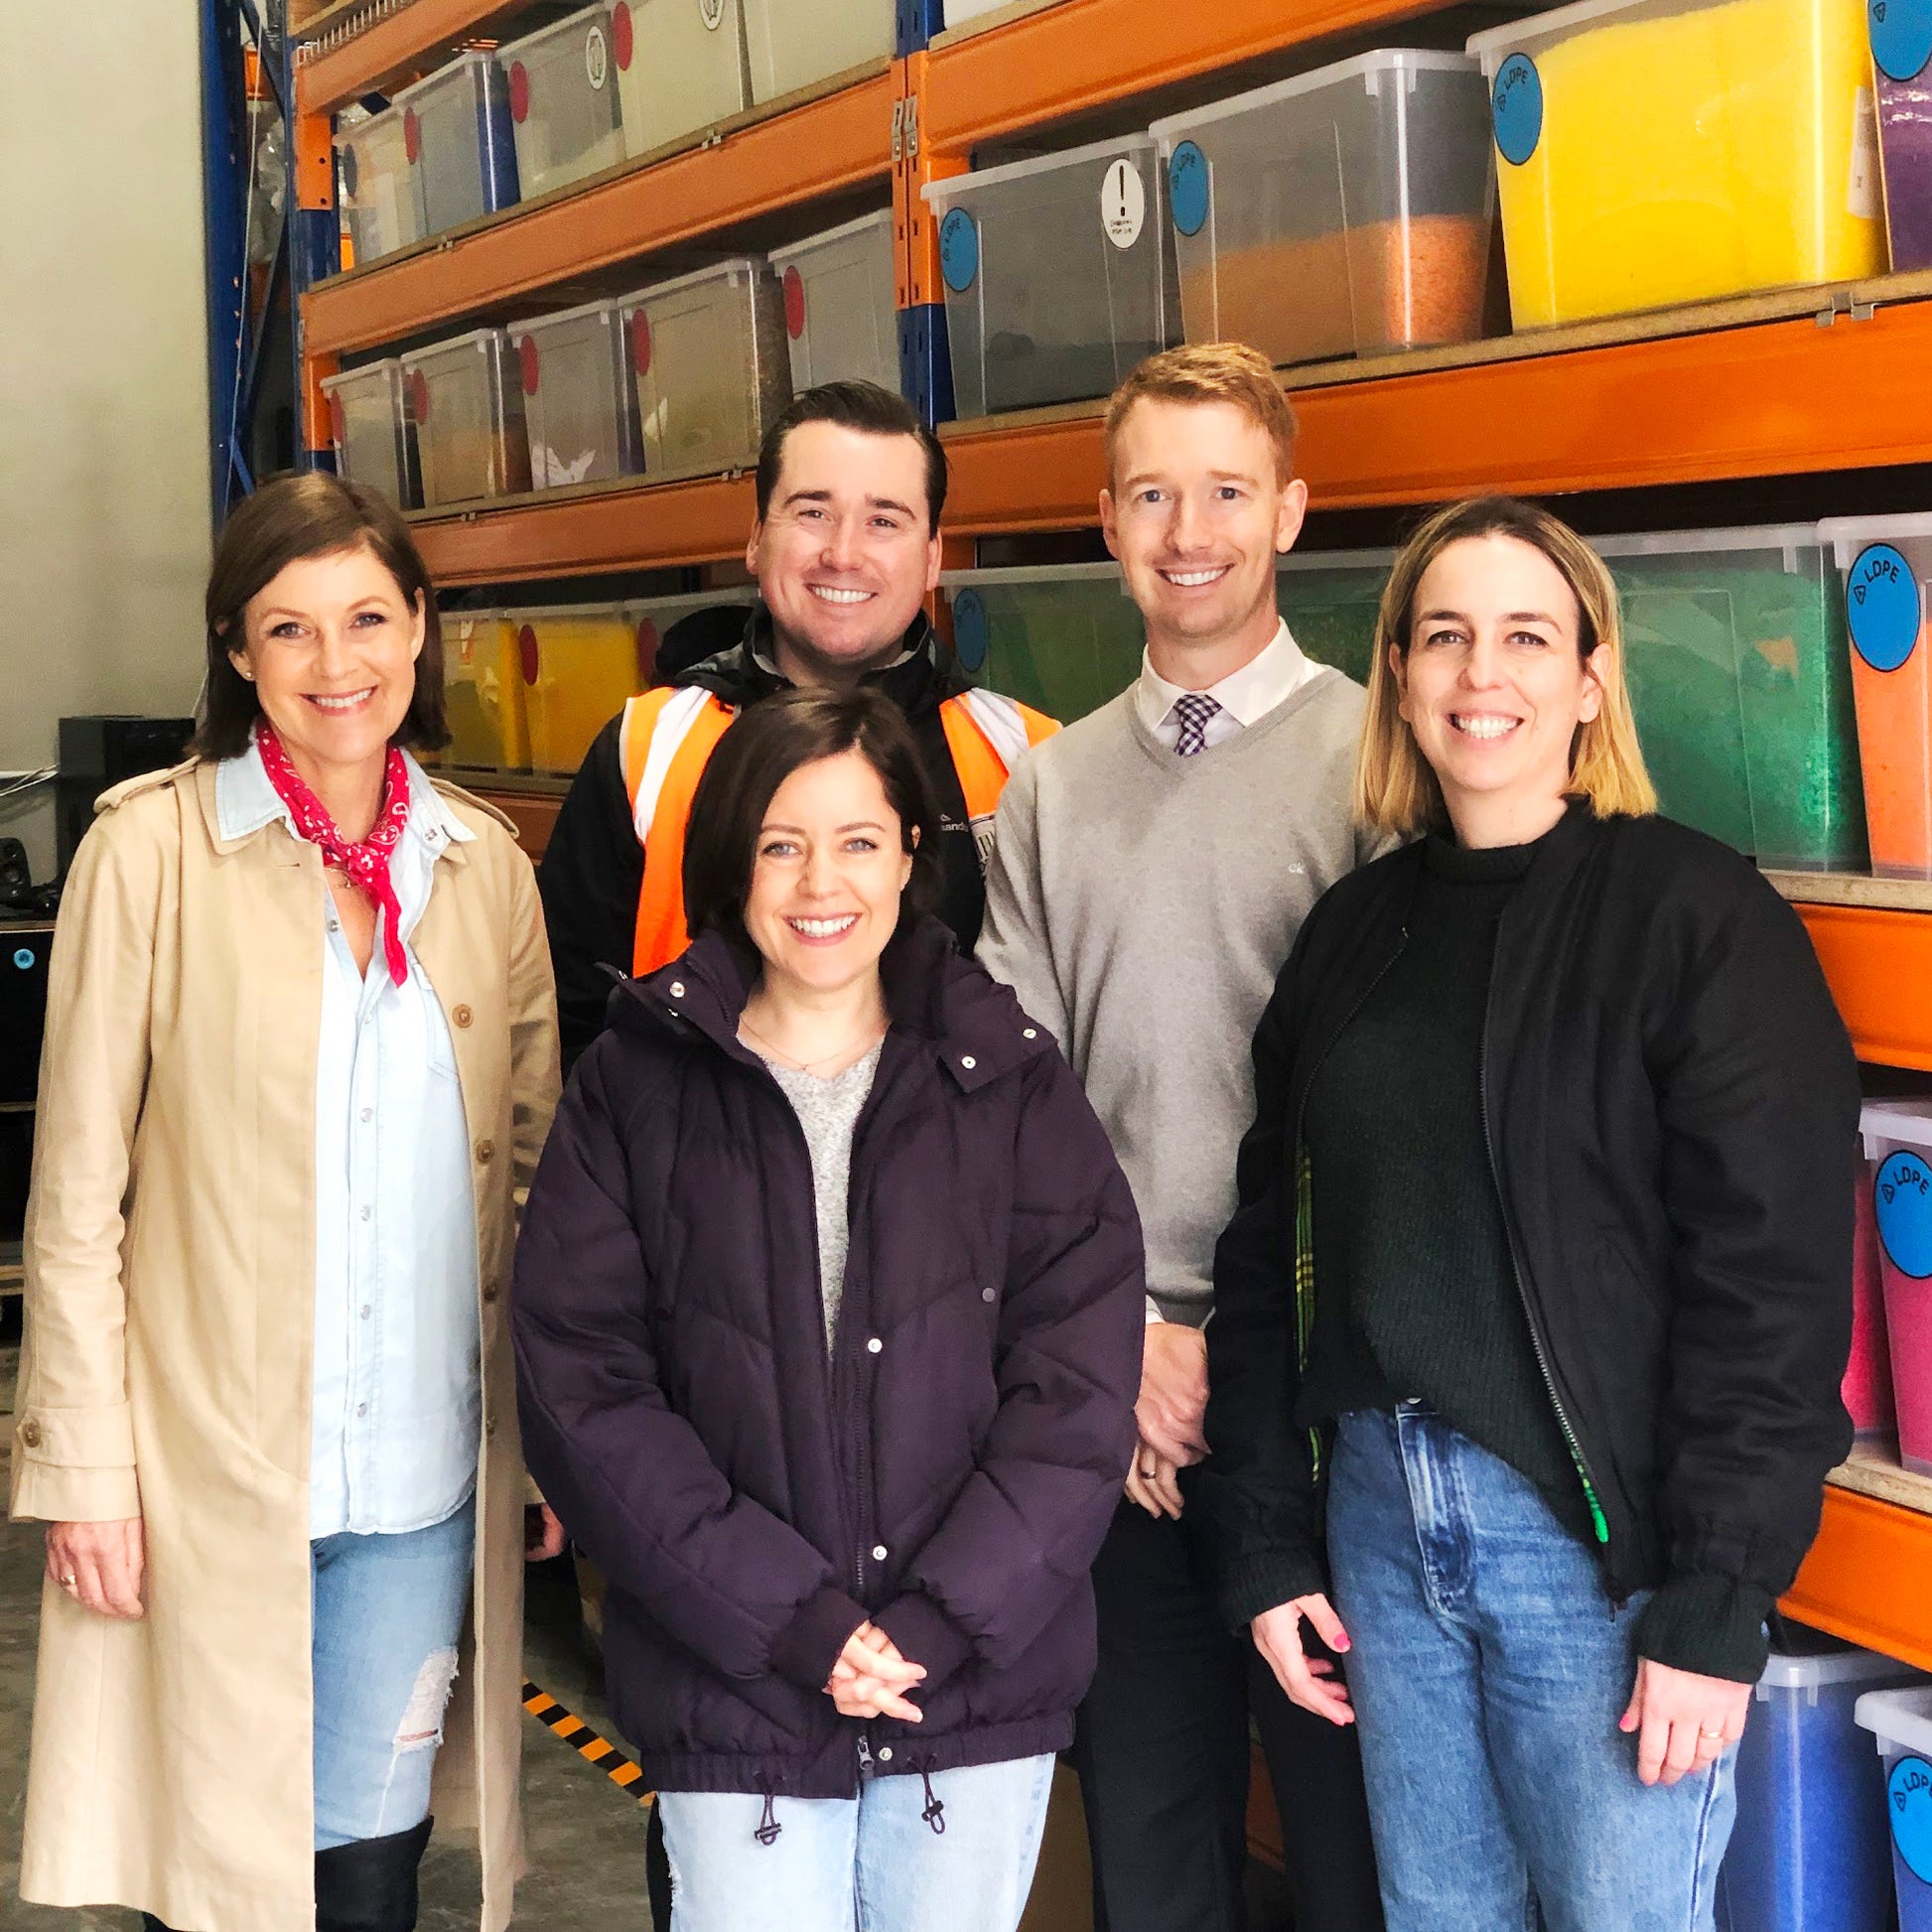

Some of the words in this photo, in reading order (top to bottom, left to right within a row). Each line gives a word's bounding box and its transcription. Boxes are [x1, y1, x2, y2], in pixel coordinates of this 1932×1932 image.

[1504, 67, 1528, 90] LDPE
[1864, 560, 1900, 584] LDPE
[1893, 1167, 1929, 1196] LDPE
